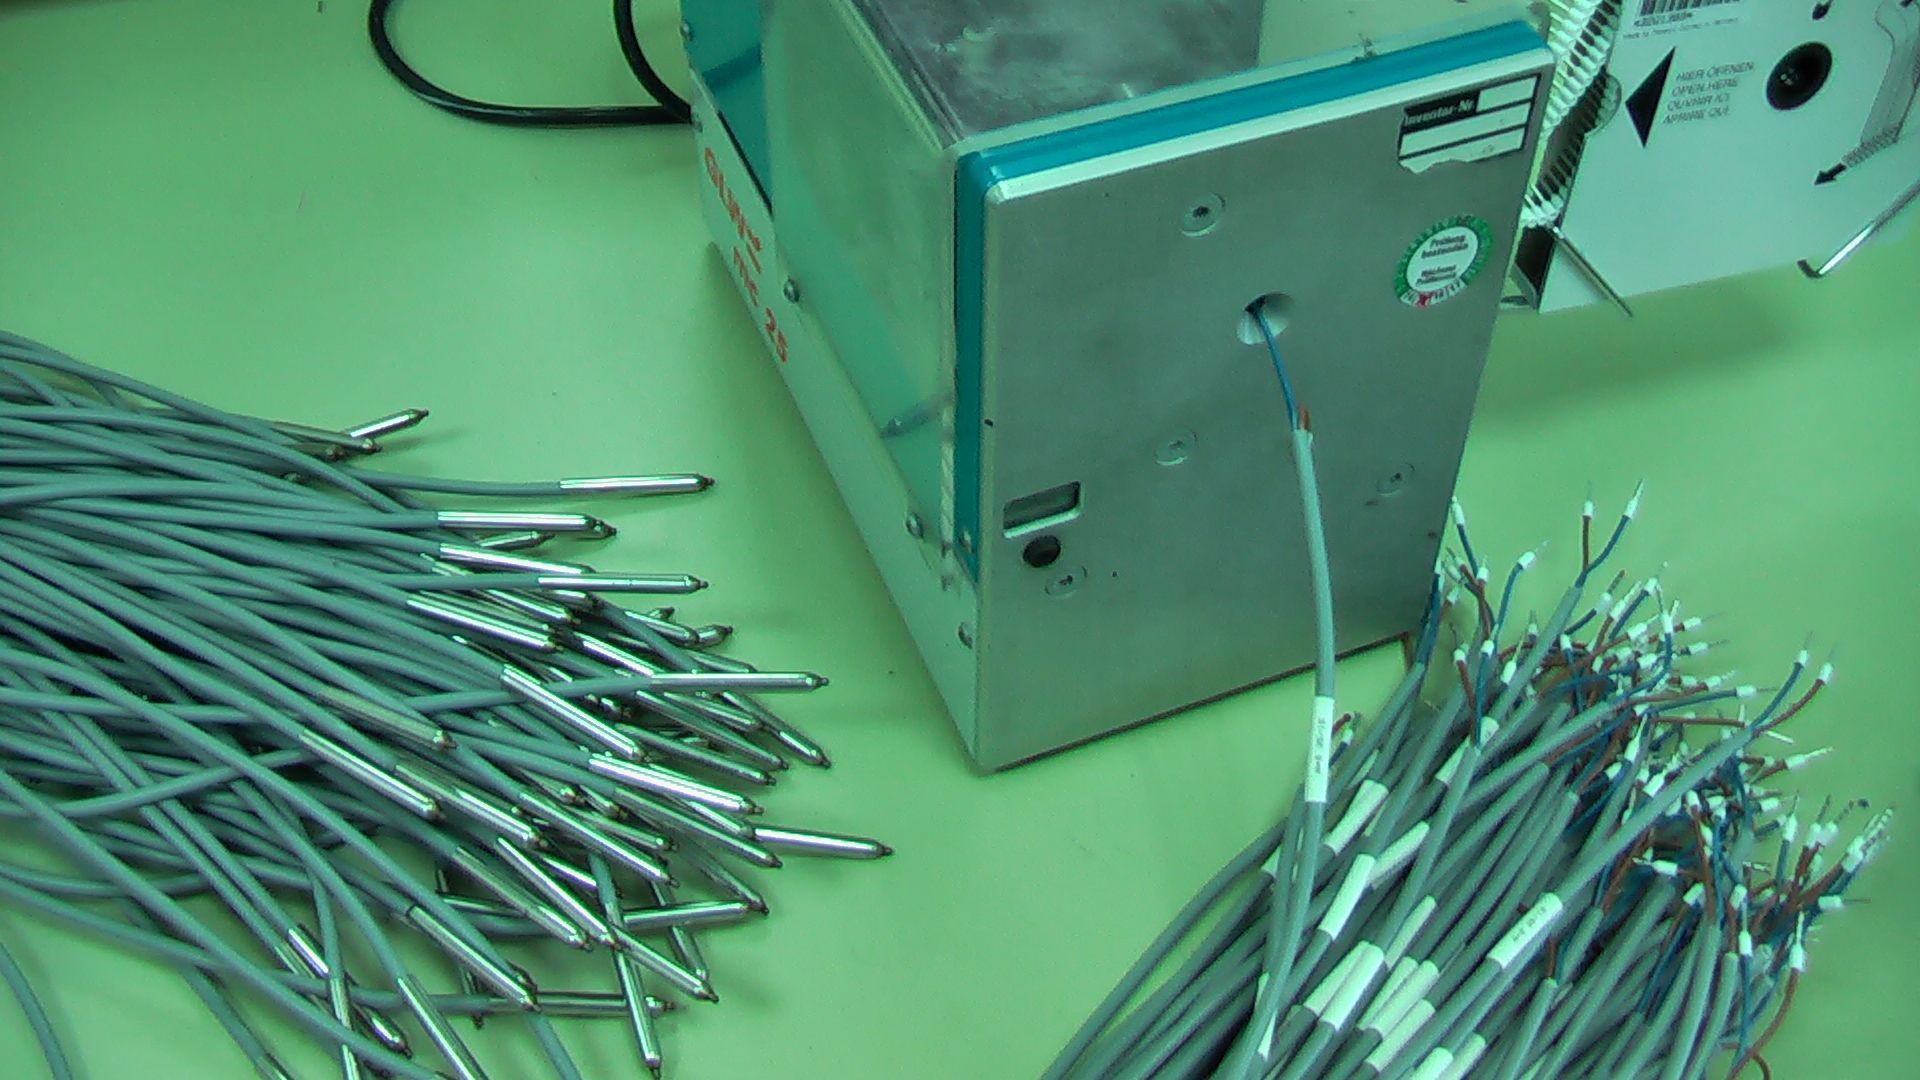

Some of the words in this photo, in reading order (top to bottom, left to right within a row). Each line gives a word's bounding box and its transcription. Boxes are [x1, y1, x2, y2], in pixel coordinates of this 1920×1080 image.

[1676, 69, 1705, 81] HIER
[1671, 82, 1706, 97] OPEN
[765, 307, 788, 364] 25
